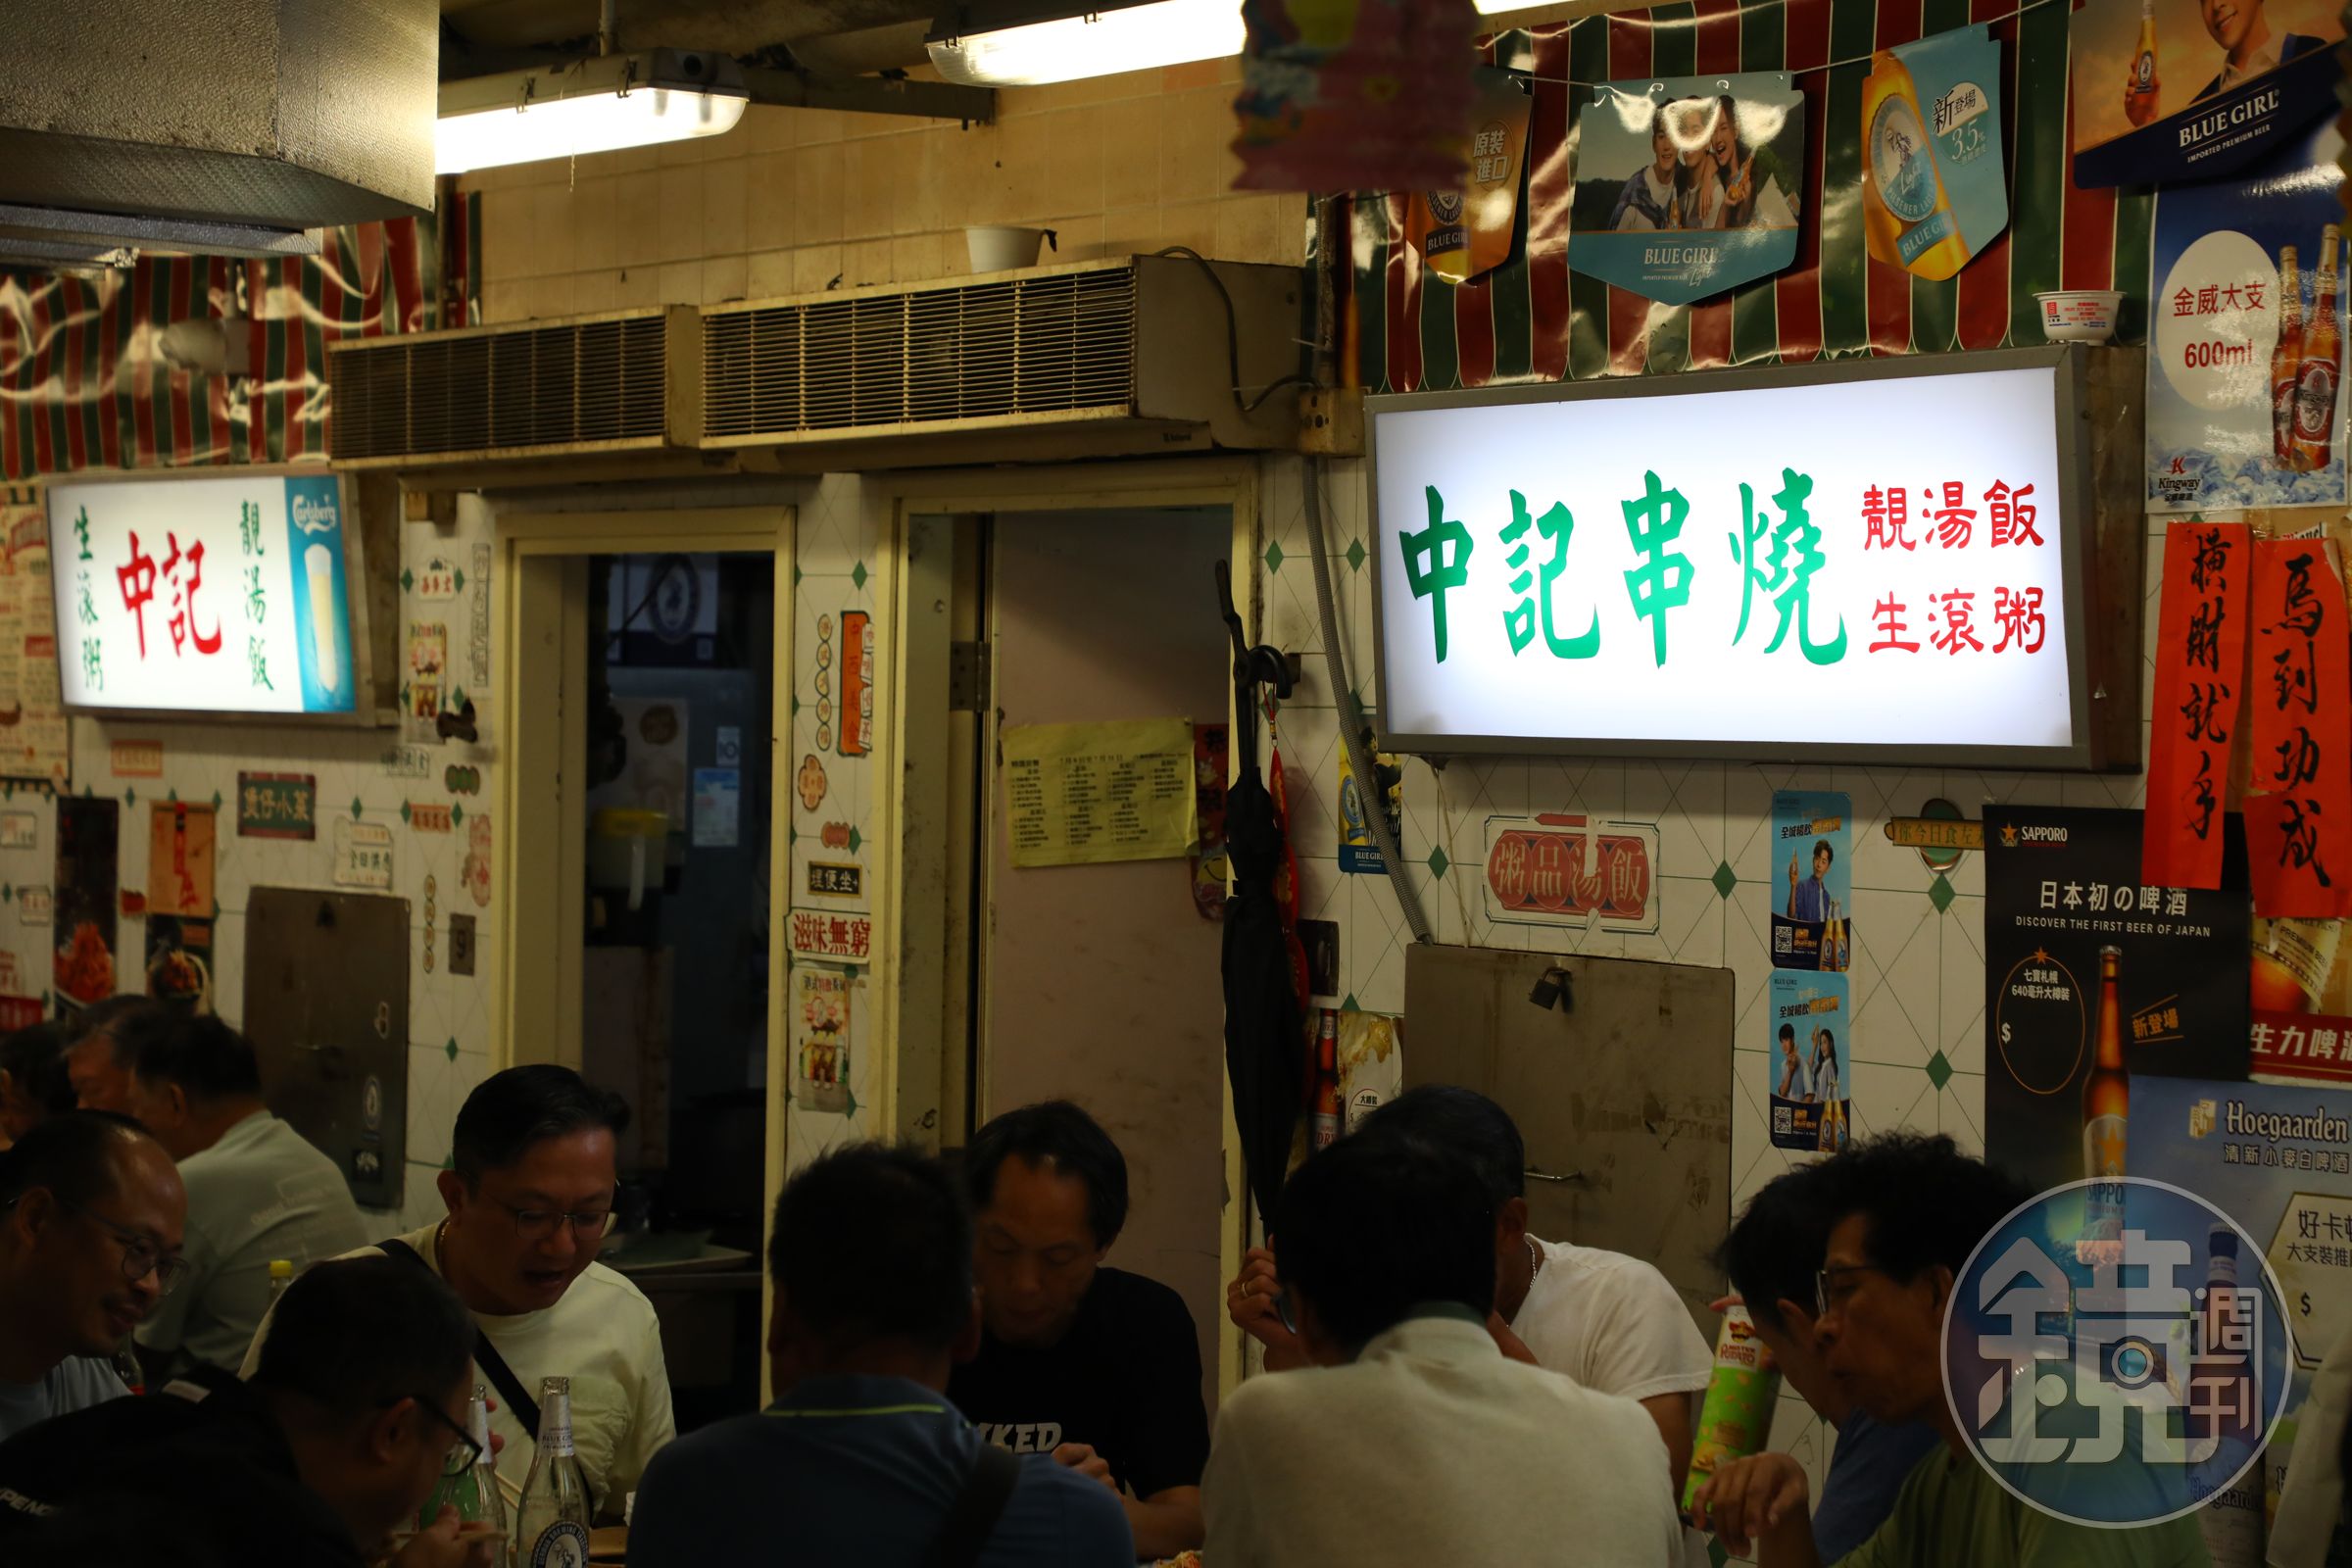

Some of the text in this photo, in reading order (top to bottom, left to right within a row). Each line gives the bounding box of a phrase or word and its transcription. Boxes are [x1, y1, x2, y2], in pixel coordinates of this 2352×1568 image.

[1933, 89, 1977, 134] 新登場
[2180, 91, 2279, 148] BLUE GIRL
[1473, 130, 1505, 158] 原裝
[2187, 123, 2271, 164] IMPORTED PREMIUM BEER
[1475, 156, 1508, 184] 進口
[1427, 232, 1451, 251] BLUE
[1644, 247, 1718, 265] BLUE GIRL
[1902, 223, 1933, 258] BLUE
[2174, 281, 2266, 317] 金威大支
[2158, 477, 2201, 491] Kingway
[292, 493, 336, 535] Carlsberg
[1862, 479, 2044, 552] 靚湯飯
[1399, 466, 1847, 668] 中記串燒
[116, 530, 222, 662] 中記
[1869, 586, 2045, 656] 生滾粥
[2260, 552, 2330, 888] 馬到功成
[2022, 826, 2068, 842] SAPPORO
[1354, 851, 1370, 859] BLUE
[2040, 880, 2187, 916] 日本初の啤酒
[794, 913, 870, 957] 滋味無窮
[2015, 916, 2211, 938] DISCOVER THE FIRST BEER OF JAPAN
[2012, 985, 2071, 1002] 640毫升大樽裝
[2001, 1021, 2012, 1045] $
[2132, 1006, 2180, 1039] 新登場
[2226, 1100, 2349, 1144] Hoegaarden
[2225, 1143, 2350, 1174] 清新小麥白啤酒
[2287, 1242, 2352, 1268] 大支裝推
[2301, 1293, 2311, 1316] $
